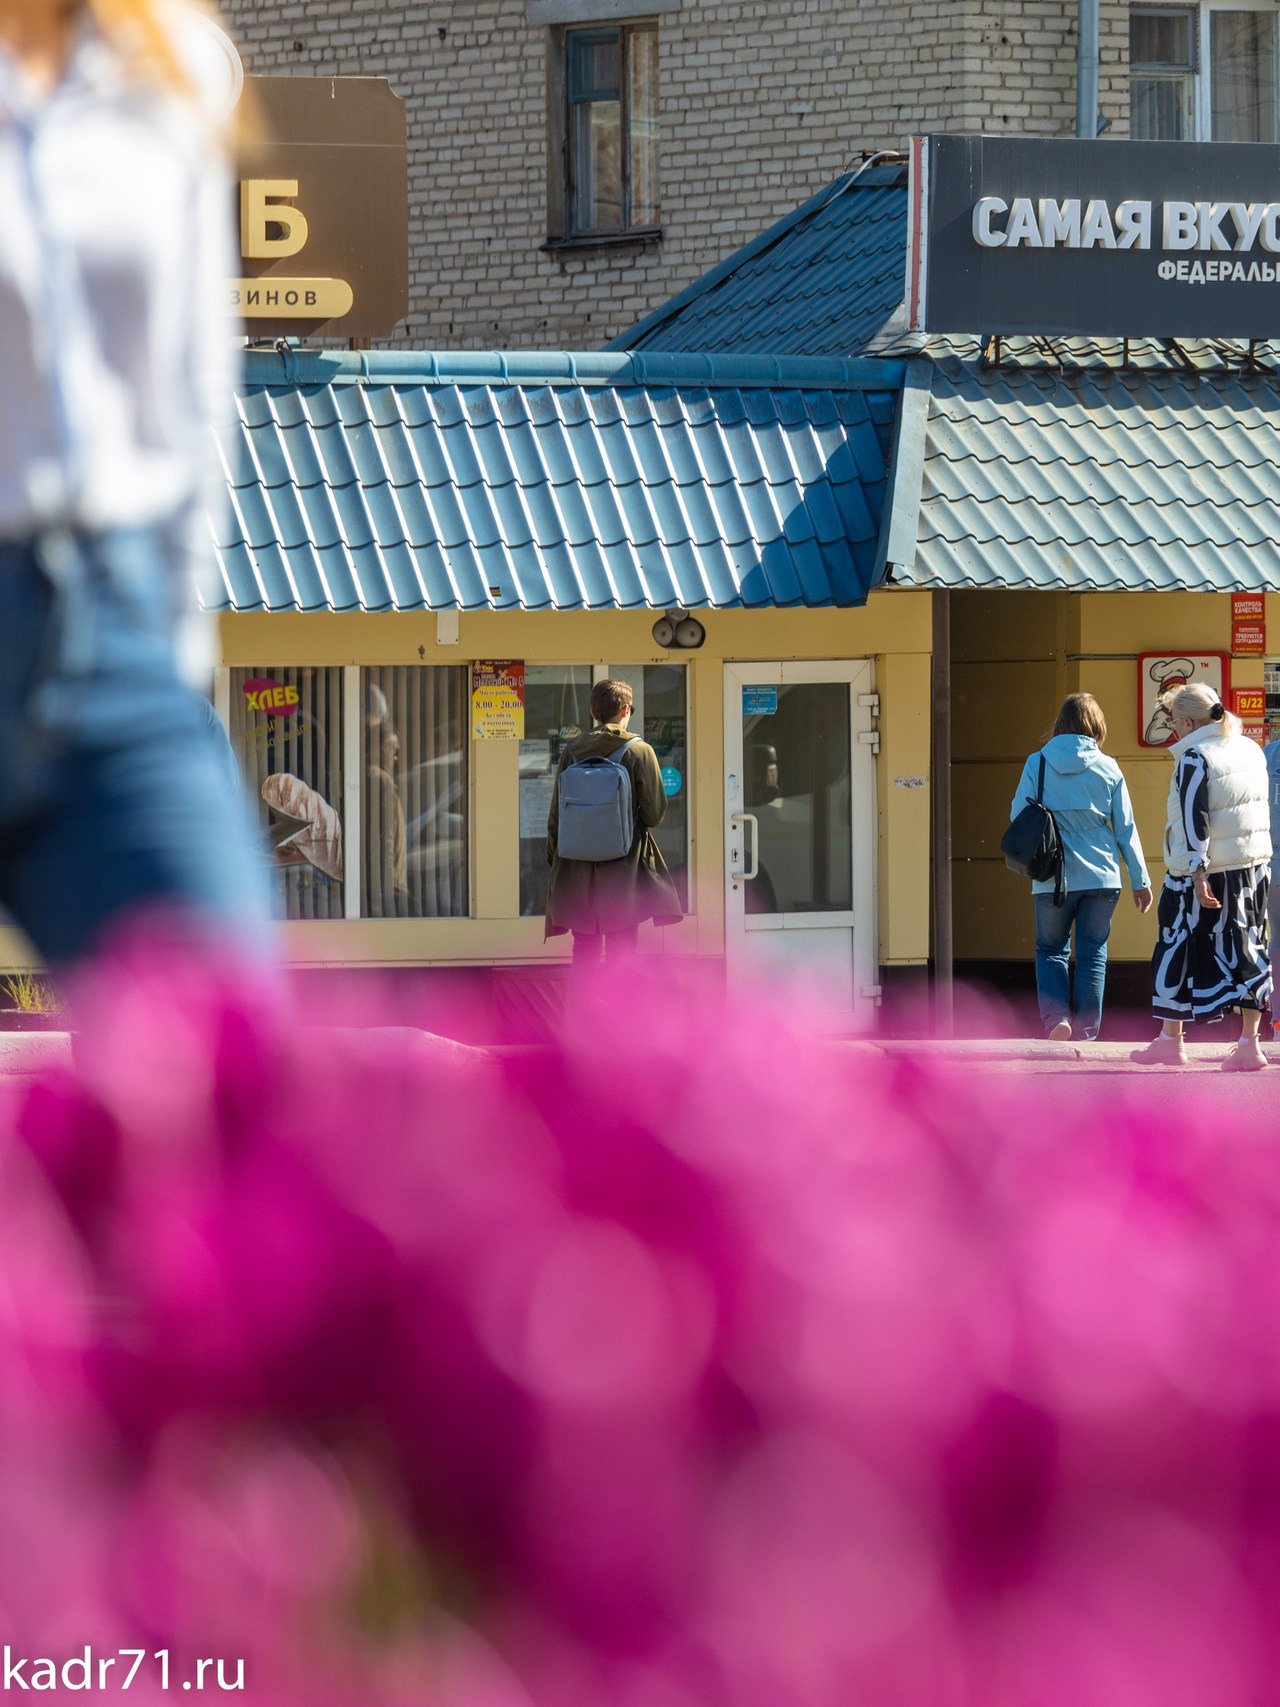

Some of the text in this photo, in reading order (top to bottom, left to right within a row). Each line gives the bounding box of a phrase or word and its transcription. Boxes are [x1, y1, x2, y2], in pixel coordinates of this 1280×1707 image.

[972, 196, 1152, 250] САМАЯ
[230, 289, 317, 306] ЗИНОВ
[246, 686, 300, 712] ХЛЕБ
[1240, 698, 1263, 708] 9/22
